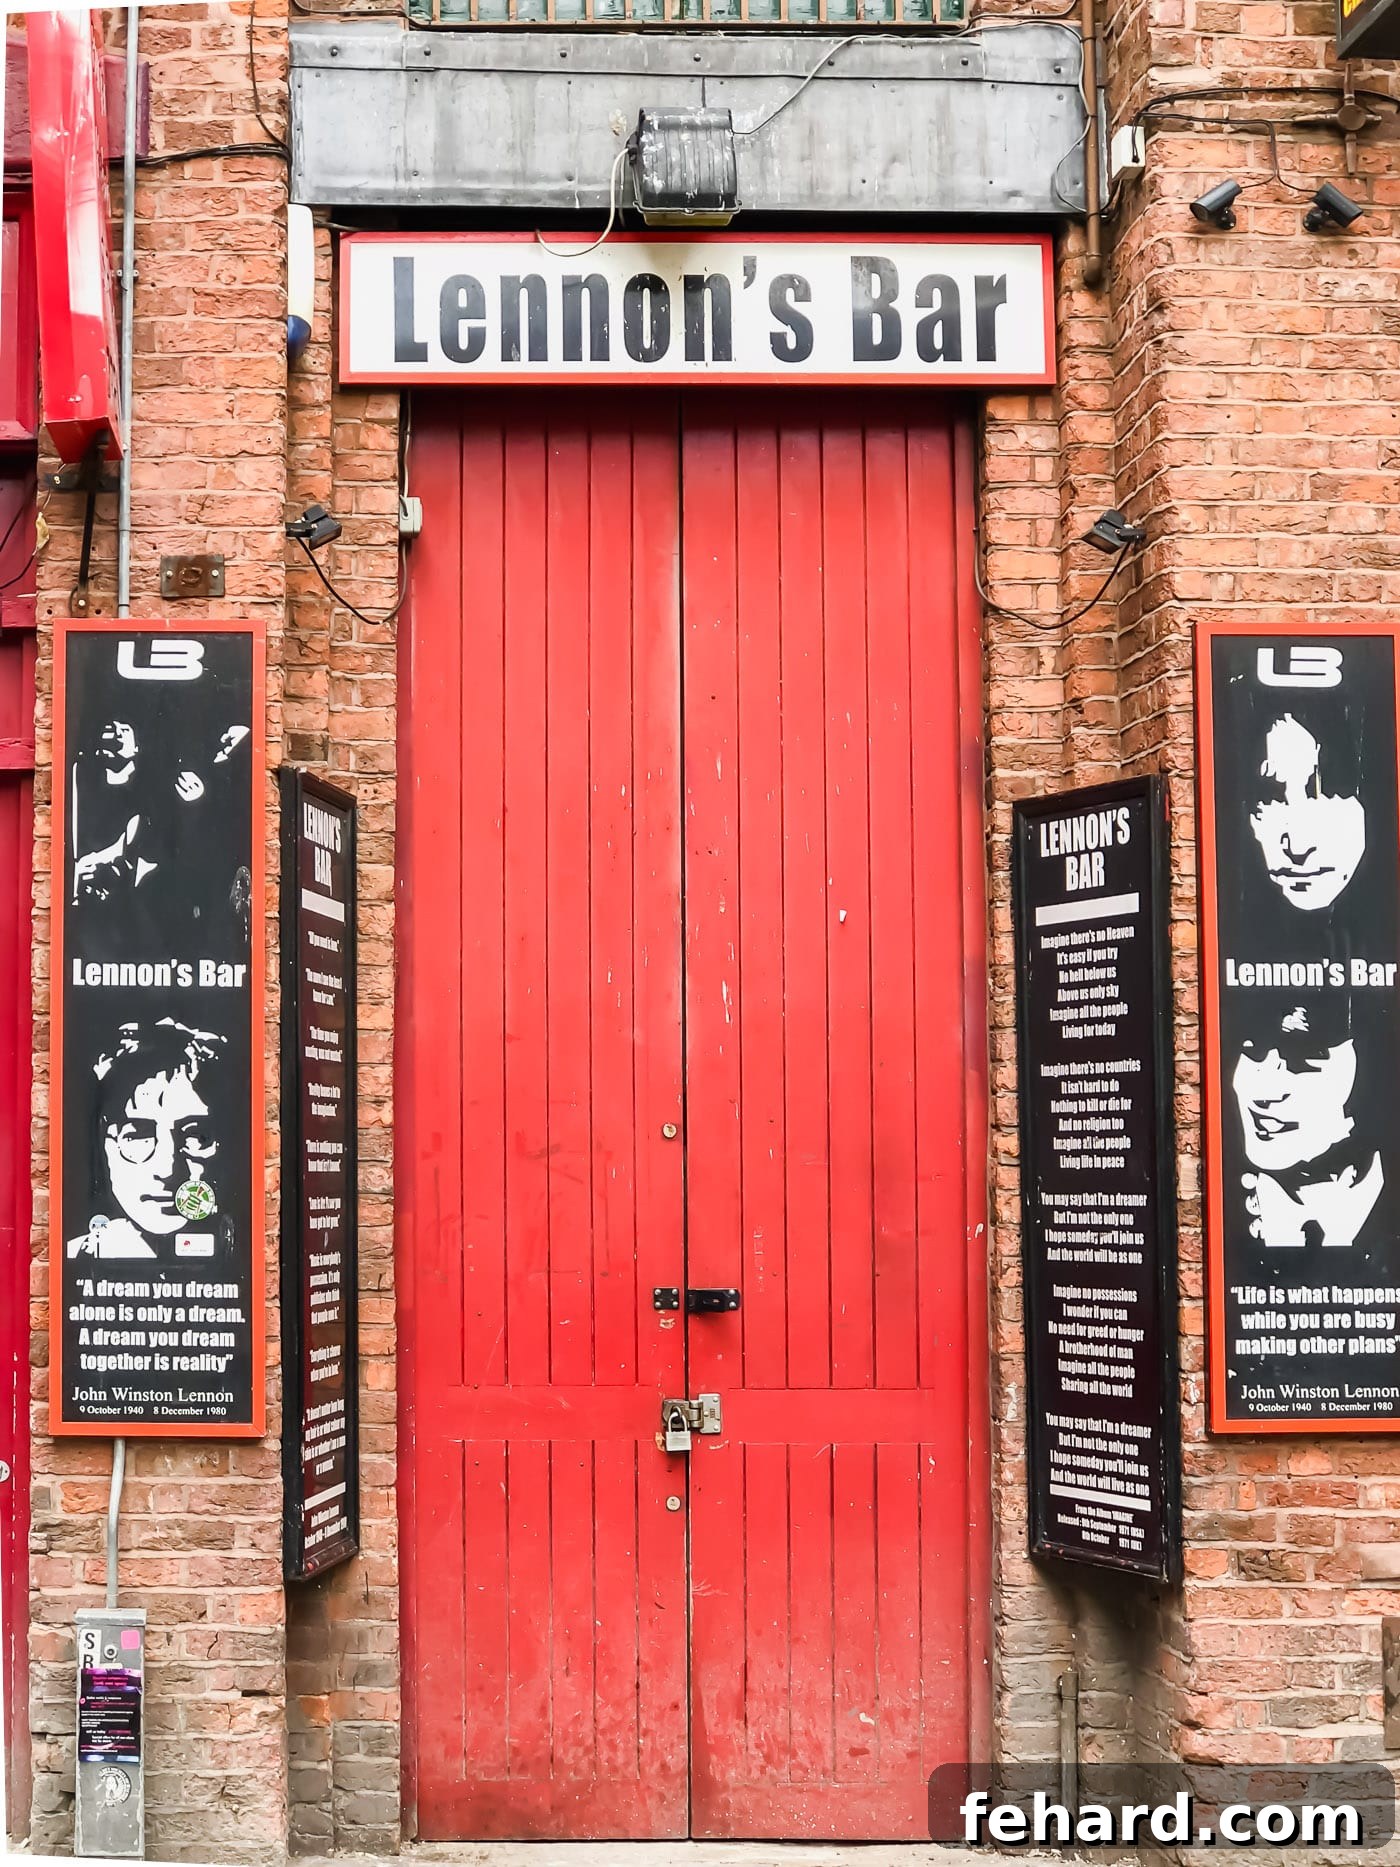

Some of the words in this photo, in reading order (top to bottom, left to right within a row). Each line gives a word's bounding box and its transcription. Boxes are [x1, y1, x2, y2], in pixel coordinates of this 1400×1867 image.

[392, 255, 813, 363] Lennon's
[850, 255, 1007, 363] Bar
[1040, 807, 1130, 857] LENNON'S
[1066, 851, 1105, 891] BAR
[1041, 934, 1069, 949] Imagine
[1070, 930, 1095, 945] there's
[1096, 930, 1105, 941] no
[1106, 926, 1134, 940] Heaven
[1057, 952, 1068, 965] It's
[1069, 951, 1086, 964] easy
[1093, 949, 1106, 962] you
[1107, 947, 1118, 960] try
[72, 958, 192, 986] Lennon's
[199, 960, 246, 988] Bar
[1059, 970, 1068, 983] No
[1069, 968, 1083, 982] hell
[1084, 967, 1106, 981] below
[1107, 967, 1116, 978] us
[1226, 958, 1344, 987] Lennon's
[1351, 958, 1397, 987] Bar
[1057, 989, 1078, 1002] Above
[1080, 988, 1089, 999] us
[1090, 985, 1105, 999] only
[1106, 984, 1119, 997] sky
[1050, 1007, 1078, 1021] Imagine
[1080, 1005, 1089, 1018] all
[1090, 1004, 1102, 1018] the
[1103, 1002, 1128, 1018] people
[1062, 1025, 1083, 1039] Living
[1084, 1024, 1094, 1037] for
[1095, 1022, 1115, 1036] today
[96, 1280, 150, 1297] dream
[153, 1283, 182, 1299] you
[186, 1281, 239, 1298] dream
[1270, 1286, 1285, 1303] is
[1288, 1286, 1329, 1303] what
[69, 1304, 115, 1321] alone
[119, 1304, 133, 1321] is
[137, 1305, 172, 1323] only
[175, 1309, 185, 1322] a
[188, 1305, 245, 1322] dream.
[1241, 1312, 1286, 1329] while
[1289, 1314, 1320, 1330] you
[1323, 1313, 1351, 1328] are
[1355, 1311, 1396, 1329] busy
[79, 1328, 90, 1345] A
[92, 1328, 145, 1346] dream
[149, 1332, 178, 1347] you
[182, 1330, 235, 1347] dream
[1236, 1336, 1296, 1356] making
[1300, 1336, 1345, 1353] other
[80, 1353, 151, 1372] together
[154, 1353, 169, 1370] is
[72, 1387, 107, 1401] John
[112, 1387, 173, 1402] Winston
[178, 1388, 233, 1402] Lennon
[1241, 1385, 1275, 1399] John
[1279, 1384, 1339, 1398] Winston
[1345, 1384, 1399, 1398] Lennon
[87, 1406, 121, 1414] October
[123, 1406, 144, 1414] 1940
[162, 1406, 203, 1415] December
[206, 1407, 227, 1415] 1980
[1292, 1403, 1311, 1411] 1940
[1329, 1403, 1370, 1411] December
[1373, 1402, 1393, 1410] 1980
[1046, 1412, 1058, 1426] You
[1059, 1415, 1074, 1429] may
[1074, 1419, 1086, 1431] say
[1088, 1418, 1102, 1432] that
[1103, 1419, 1114, 1433] I'm
[1115, 1423, 1119, 1434] a
[1120, 1422, 1152, 1439] dreamer
[1059, 1432, 1070, 1446] But
[1071, 1434, 1082, 1448] I'm
[1083, 1437, 1095, 1449] not
[1095, 1438, 1107, 1451] the
[1108, 1440, 1124, 1455] only
[1125, 1444, 1139, 1456] one
[1050, 1450, 1053, 1462] I
[1054, 1450, 1071, 1465] hope
[1072, 1454, 1103, 1471] someday
[1104, 1458, 1124, 1473] you'll
[1125, 1461, 1139, 1475] join
[1140, 1465, 1149, 1477] us
[1051, 1468, 1064, 1482] And
[1065, 1471, 1076, 1484] the
[1077, 1473, 1096, 1487] world
[1097, 1476, 1111, 1489] will
[1112, 1477, 1124, 1492] live
[1126, 1482, 1134, 1494] as
[1136, 1484, 1149, 1496] one
